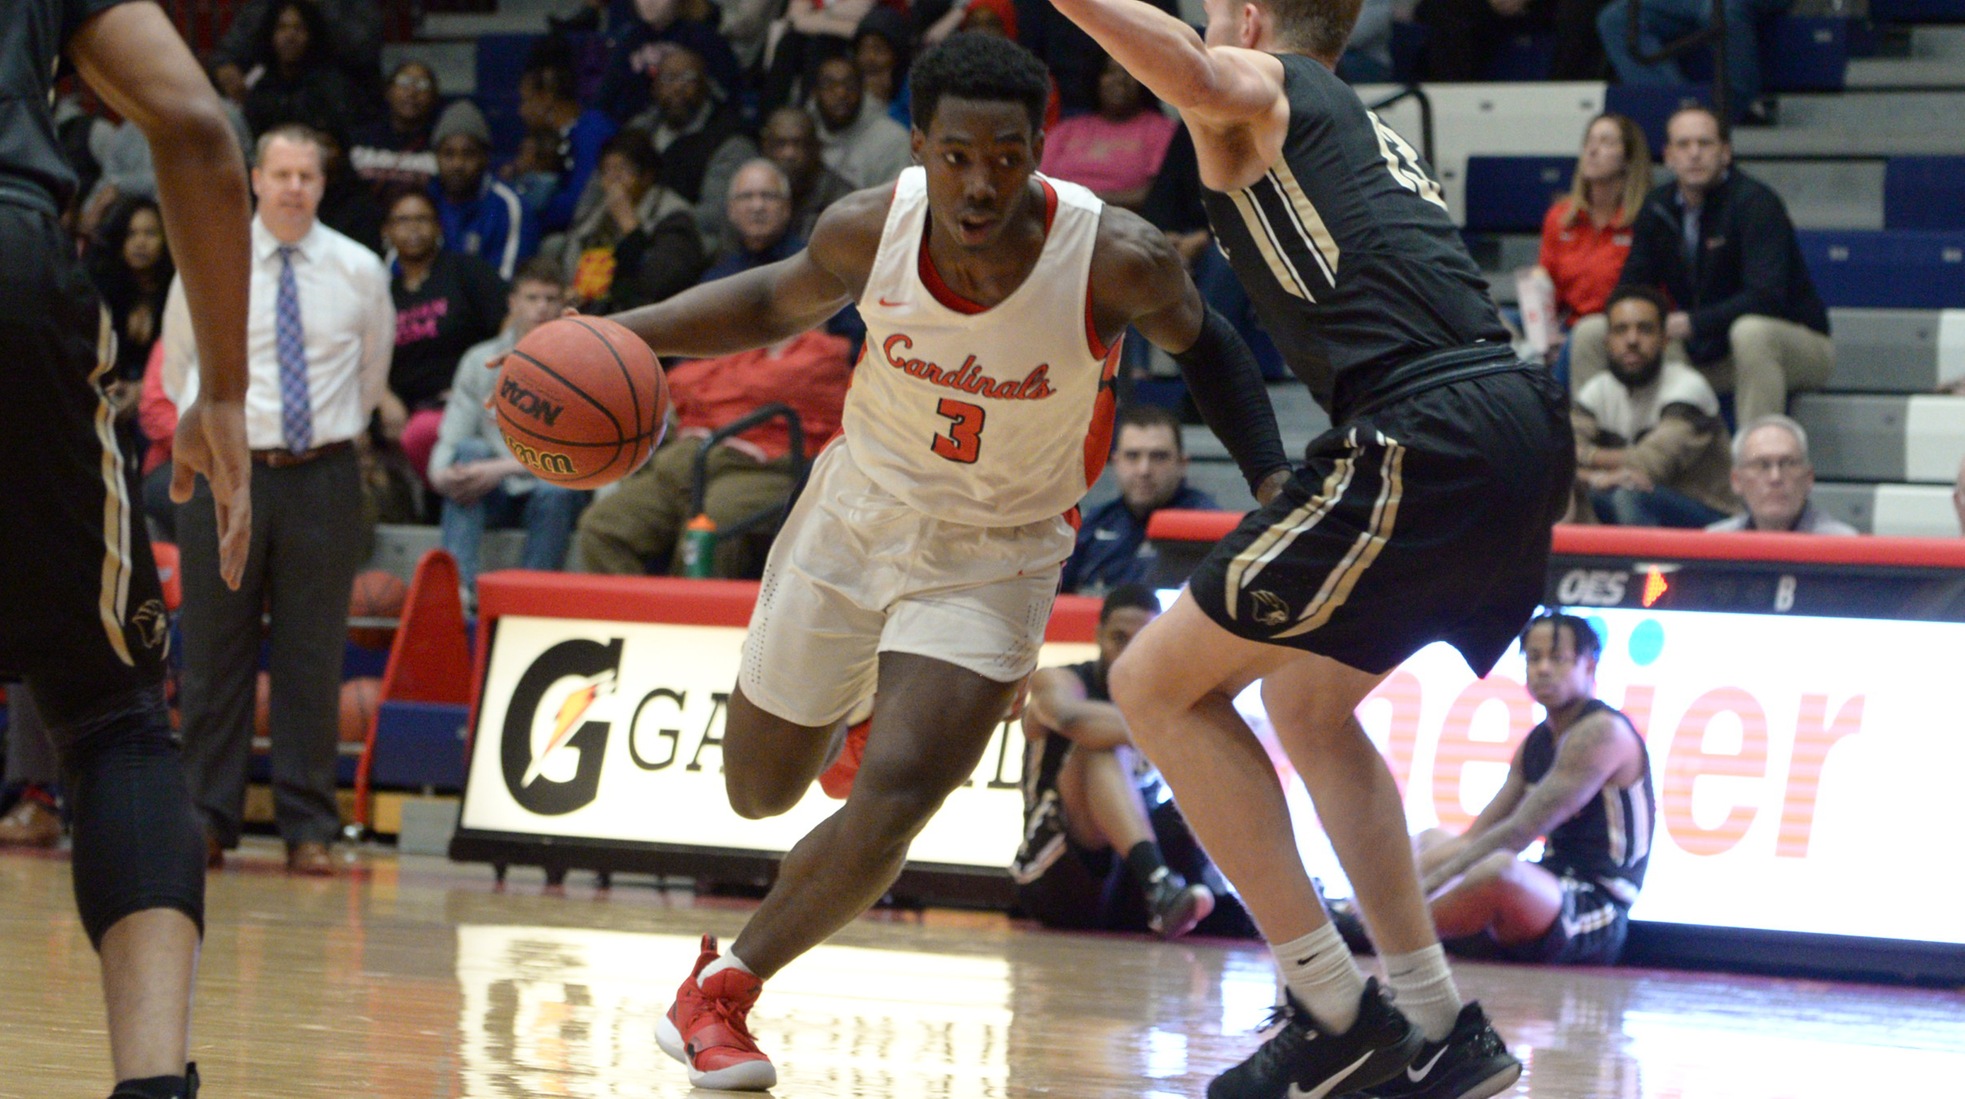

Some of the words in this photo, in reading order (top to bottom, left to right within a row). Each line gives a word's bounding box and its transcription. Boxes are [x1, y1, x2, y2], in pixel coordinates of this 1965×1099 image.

[883, 333, 1057, 399] Cardinals
[501, 376, 564, 427] NCAA
[931, 397, 985, 464] 3
[1557, 568, 1629, 605] OES
[500, 637, 625, 816] G
